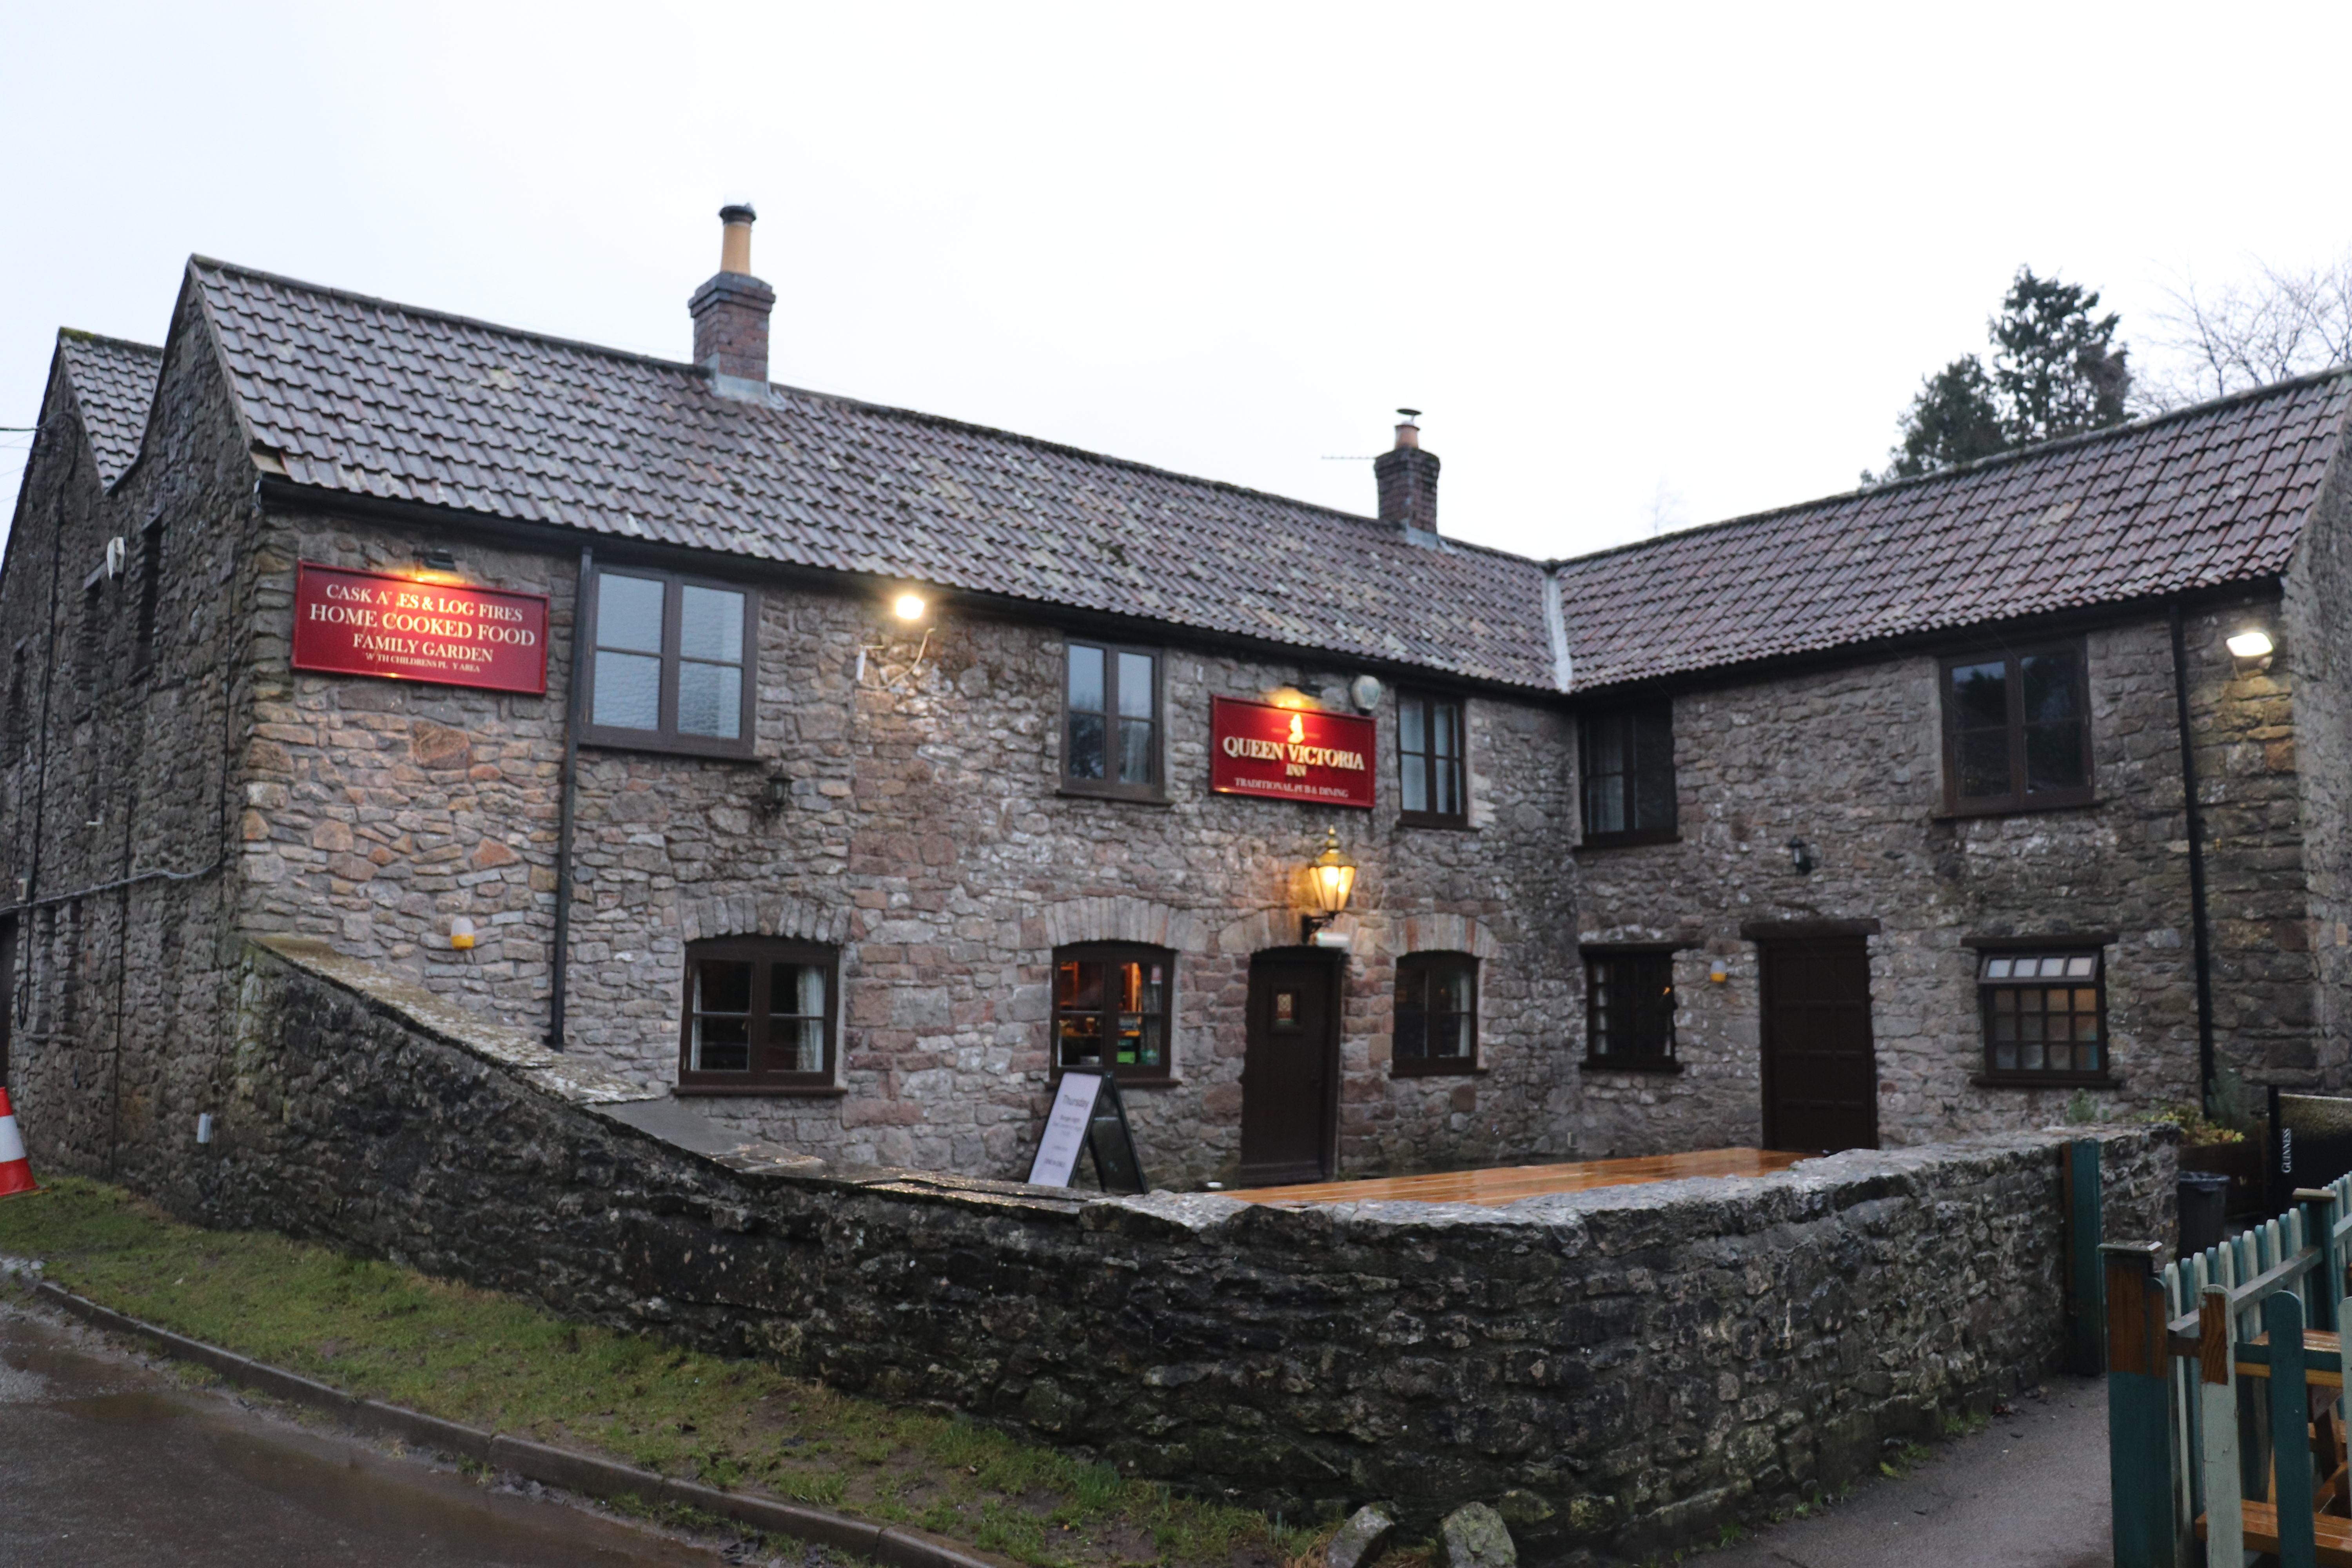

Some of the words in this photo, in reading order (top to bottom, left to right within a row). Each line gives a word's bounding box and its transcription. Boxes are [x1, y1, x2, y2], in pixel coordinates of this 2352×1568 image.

[326, 583, 372, 604] CASK
[421, 596, 434, 612] &
[438, 598, 474, 617] LOG
[478, 603, 523, 622] FIRES
[309, 603, 377, 628] HOME
[382, 612, 473, 639] COOKED
[477, 623, 535, 646] FOOD
[353, 633, 419, 654] FAMILY
[422, 641, 494, 662] GARDEN
[365, 652, 389, 662] WTH
[390, 655, 437, 668] CHILDRENS
[438, 661, 459, 670] PLY
[459, 662, 481, 673] AREA
[1222, 736, 1285, 760] QUEEN
[1287, 744, 1365, 771] VICTORIA
[1285, 763, 1307, 777] INN
[1235, 777, 1294, 792] TRADITIONAL
[1294, 784, 1311, 794] PUB
[1318, 786, 1349, 798] DINING
[2281, 1128, 2291, 1173] GUINNESS
